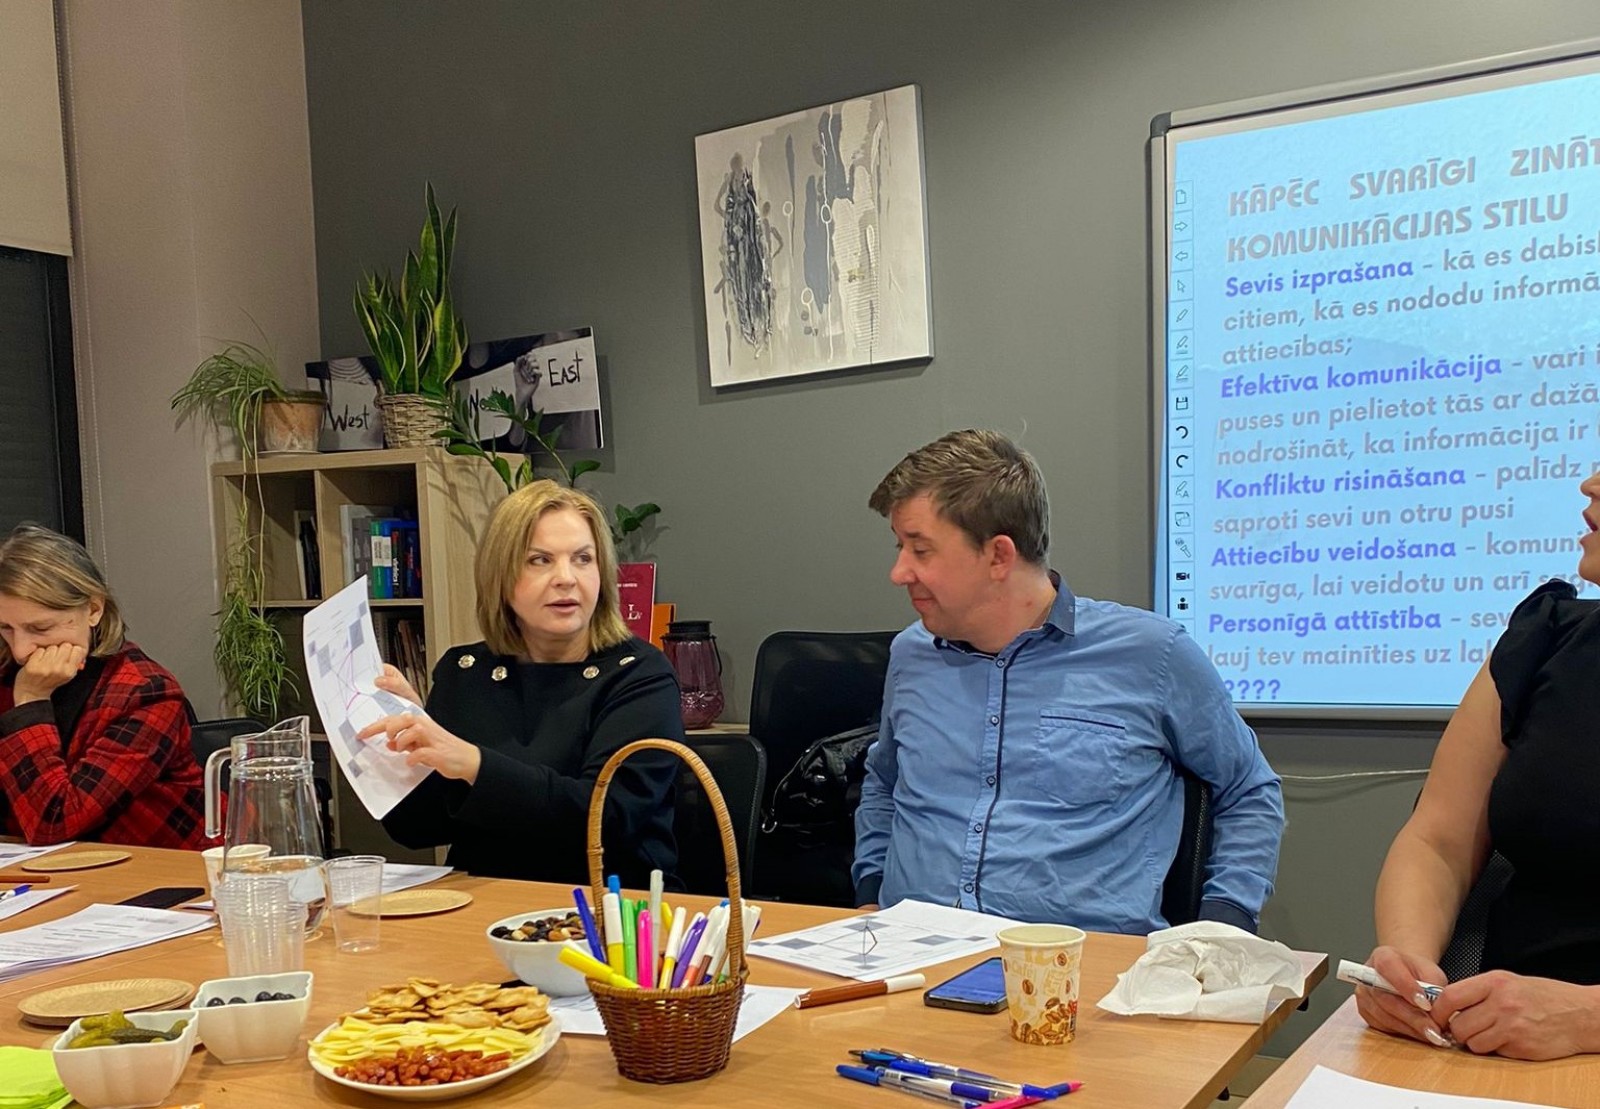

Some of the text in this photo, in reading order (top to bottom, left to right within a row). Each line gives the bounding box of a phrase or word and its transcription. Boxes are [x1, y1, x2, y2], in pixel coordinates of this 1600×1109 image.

[1231, 178, 1319, 216] KĀPĒC
[1350, 156, 1476, 200] SVARĪGI
[1228, 193, 1568, 262] KOMUNIKĀCIJAS STILU
[1225, 272, 1284, 297] Sevis
[1292, 261, 1414, 295] izprašana
[1443, 248, 1475, 271] kā
[1484, 250, 1512, 267] es
[1224, 308, 1305, 330] citiem,
[1315, 298, 1344, 321] kā
[1352, 300, 1378, 316] es
[1387, 281, 1483, 312] nododu
[548, 350, 583, 387] East
[1223, 334, 1352, 364] attiecības;
[1221, 373, 1319, 398] Efektīva
[1327, 354, 1502, 388] komunikācija
[1533, 344, 1585, 370] vari
[328, 404, 370, 431] West
[1220, 413, 1284, 439] puses
[1293, 410, 1320, 426] un
[1329, 396, 1437, 431] pielietot
[1444, 394, 1484, 414] tās
[1493, 393, 1522, 410] ar
[1219, 438, 1354, 465] nodrošināt,
[1365, 432, 1395, 454] ka
[1404, 421, 1559, 452] informācija
[1569, 419, 1589, 440] ir
[1216, 472, 1325, 499] Konfliktu
[1334, 466, 1466, 492] risināšana
[1497, 454, 1581, 490] palīdz
[1214, 497, 1513, 539] saproti sevi un otru pusi
[1211, 541, 1320, 567] Attiecību
[1328, 537, 1456, 561] veidošana
[1211, 581, 1304, 604] svarīga,
[1313, 574, 1342, 596] lai
[1351, 570, 1445, 595] veidotu
[1454, 576, 1483, 592] un
[1493, 571, 1530, 591] arī
[1209, 612, 1327, 638] Personīgā
[1334, 605, 1441, 631] attīstība
[1258, 647, 1295, 665] tev
[1303, 643, 1415, 664] mainīties
[1425, 649, 1451, 663] uz
